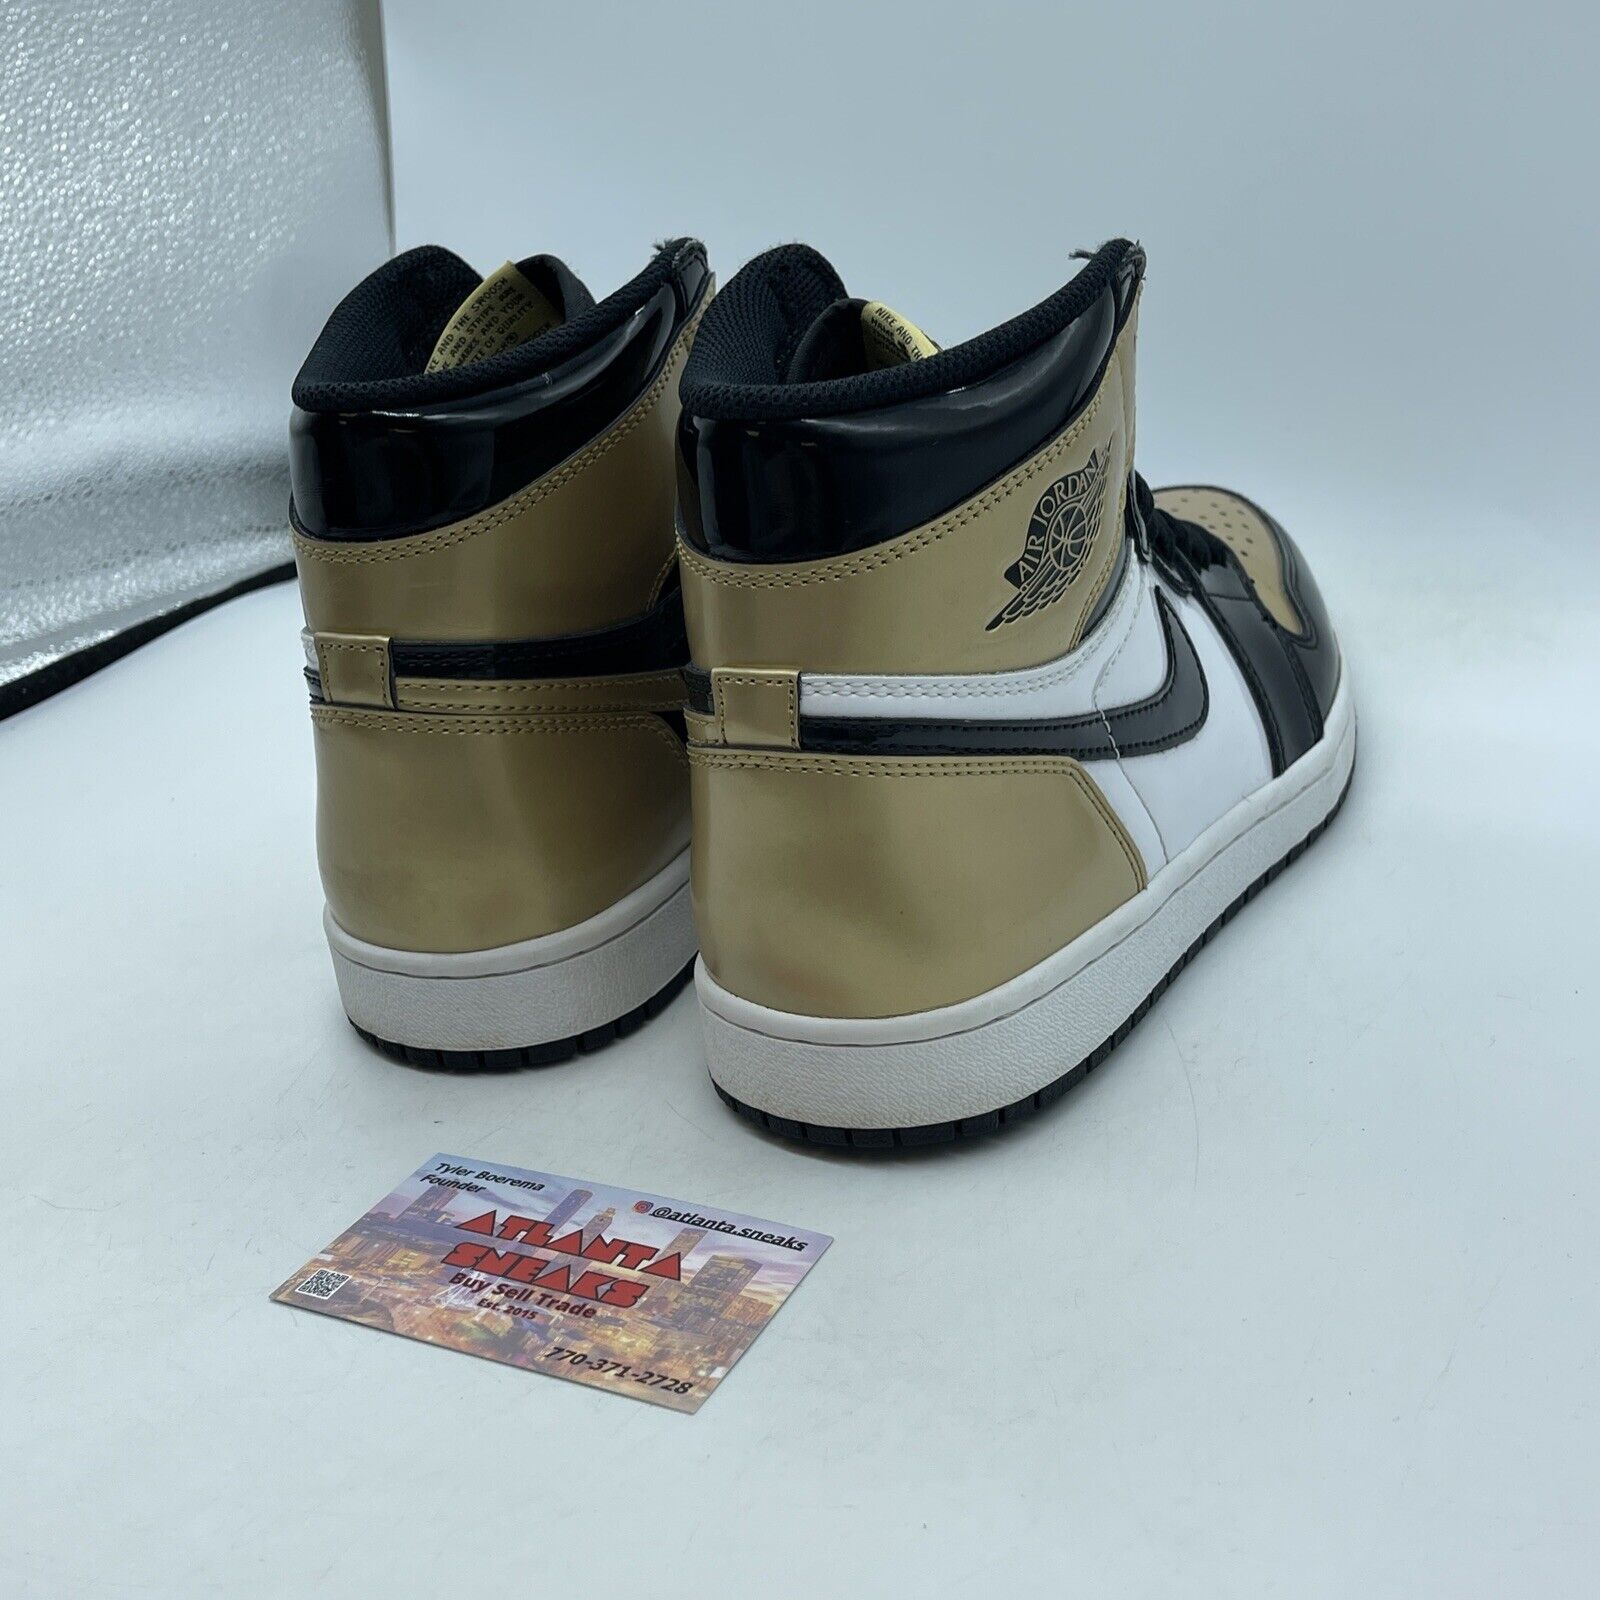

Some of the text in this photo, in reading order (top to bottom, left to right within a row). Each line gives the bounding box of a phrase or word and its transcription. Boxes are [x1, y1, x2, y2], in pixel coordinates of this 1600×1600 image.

[437, 333, 454, 356] AND
[453, 312, 471, 332] THE
[449, 336, 467, 358] AND
[480, 315, 499, 337] AND
[875, 307, 898, 328] NIKE
[895, 325, 913, 345] AND
[911, 345, 922, 360] TH
[1018, 458, 1099, 582] AIR JORDAN
[420, 1174, 487, 1194] Founder
[435, 1162, 546, 1192] Tyler Boerema
[454, 1209, 681, 1281] ATLANTA
[652, 1205, 809, 1252] @atlanta.sneaks
[440, 1241, 650, 1309] SNEAKS
[448, 1272, 599, 1320] Buy Sell Trade
[477, 1298, 539, 1321] Est. 2015
[544, 1346, 694, 1395] 770-371-2728
